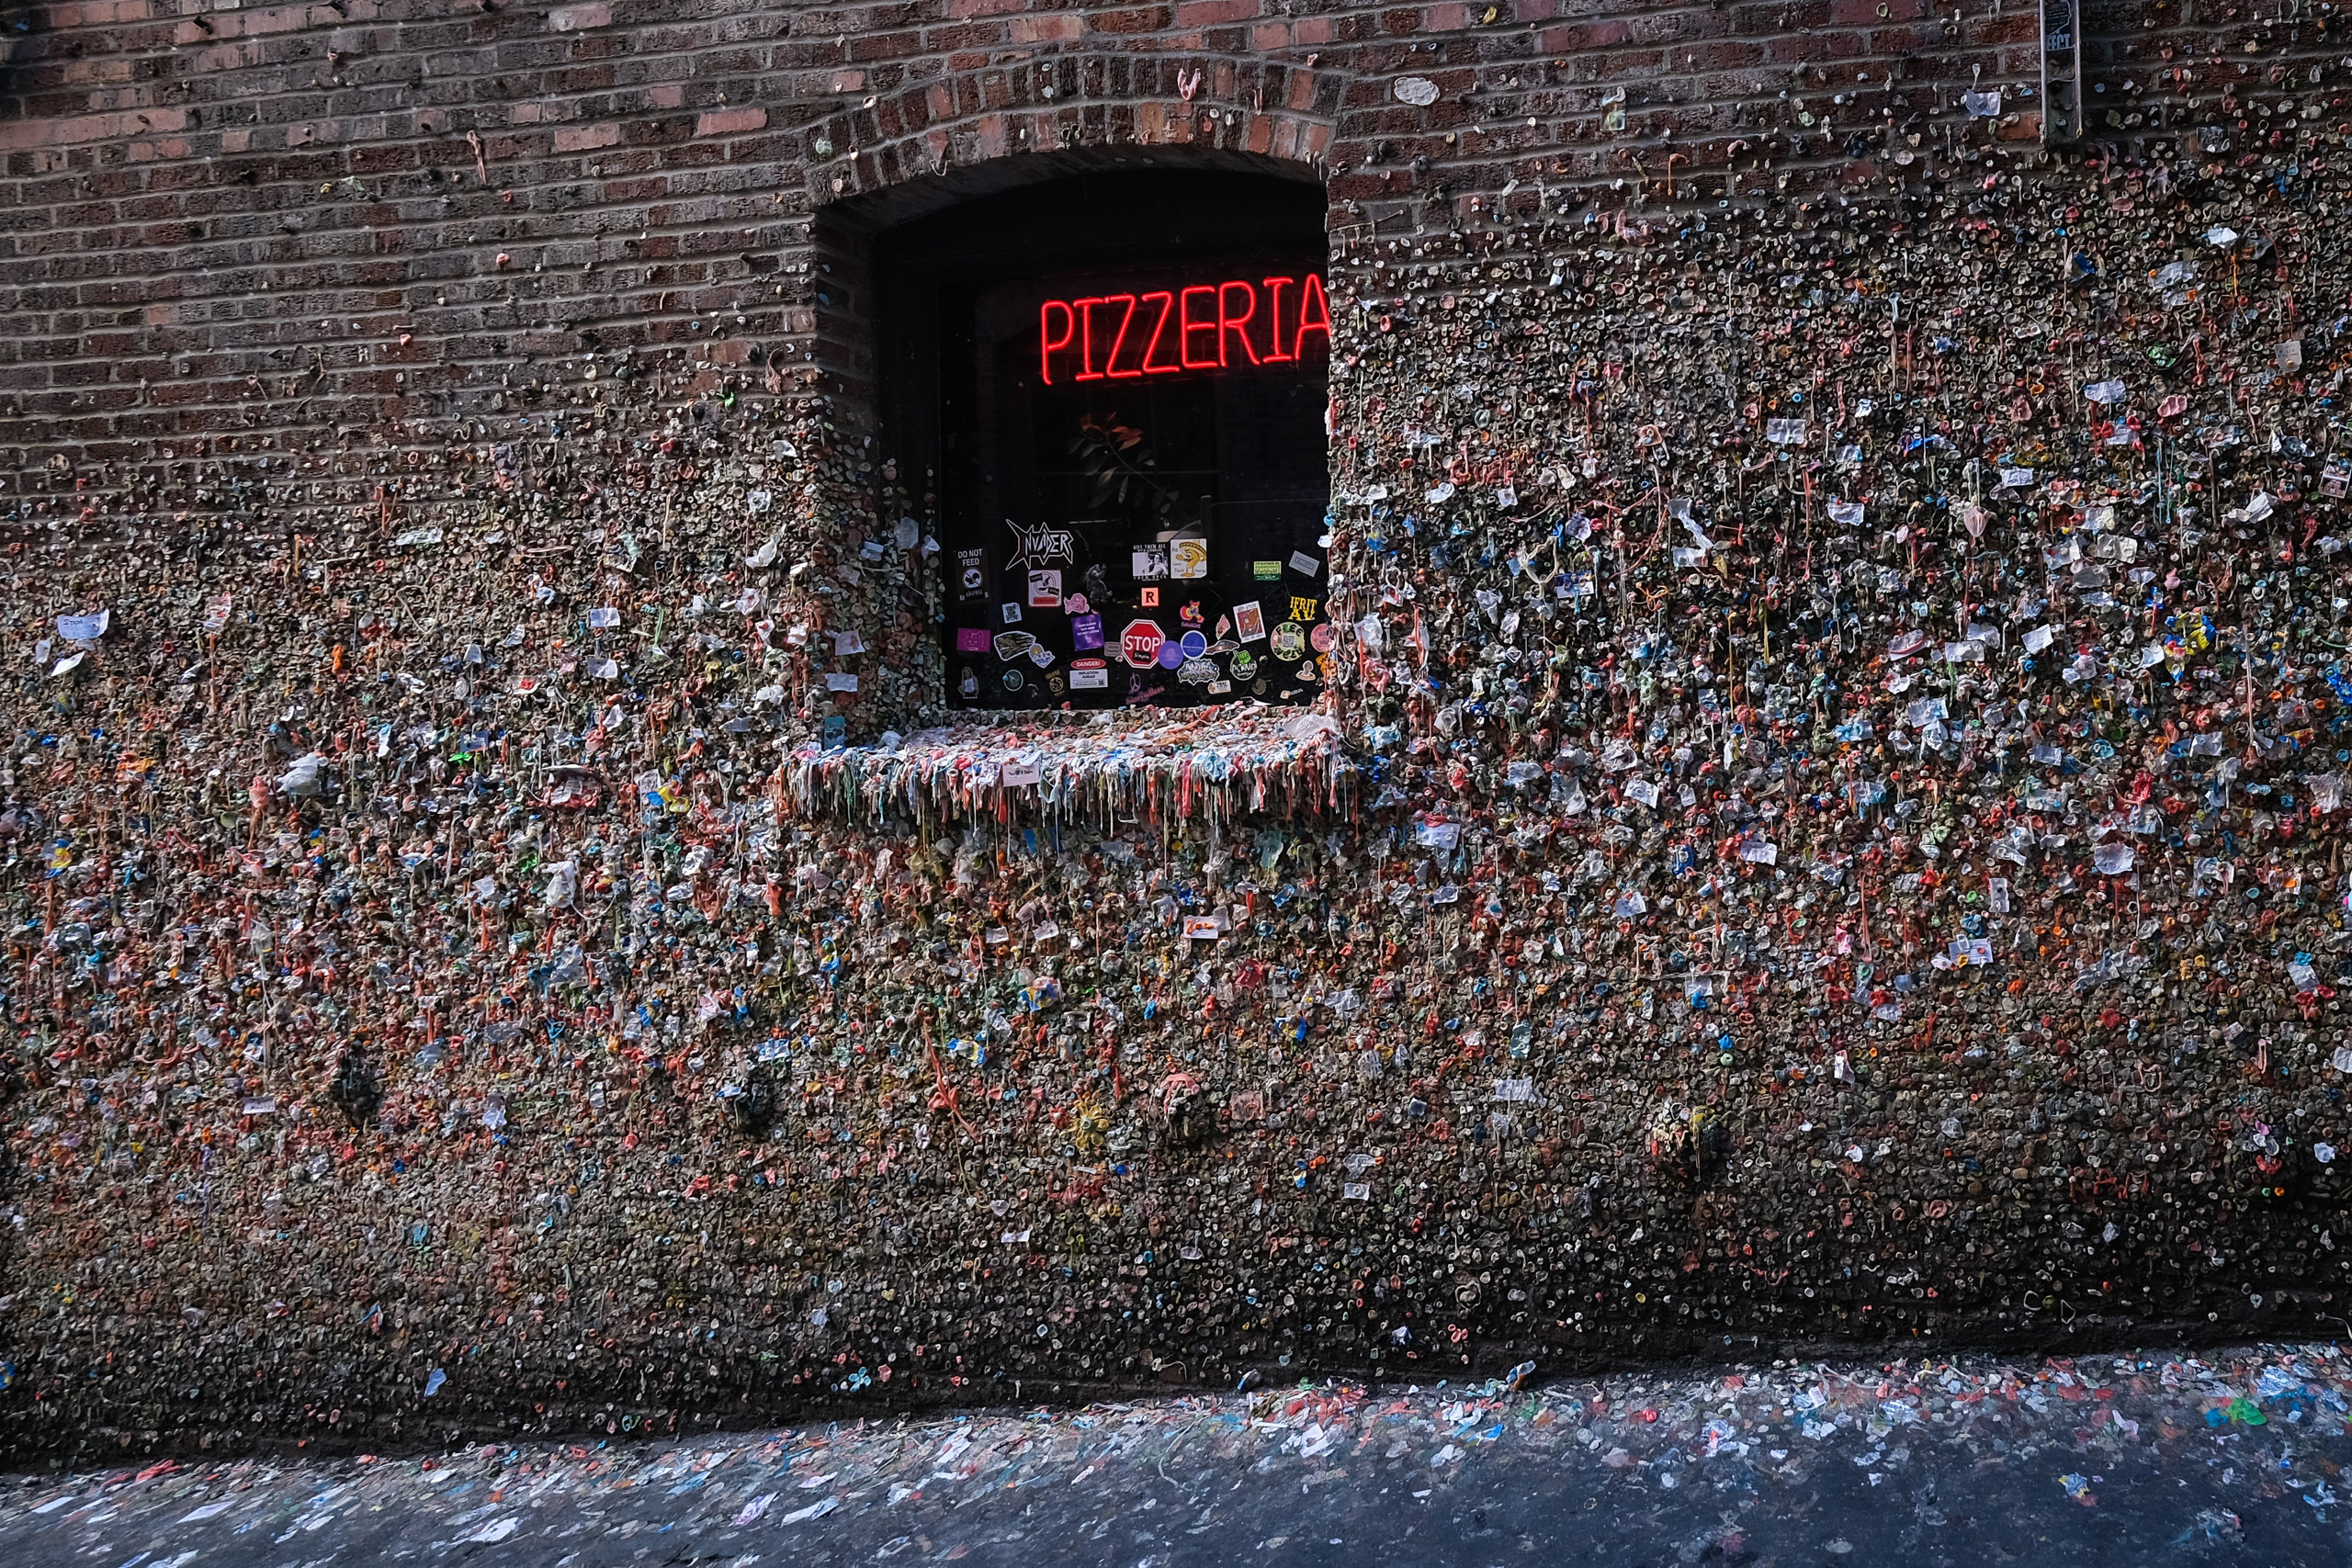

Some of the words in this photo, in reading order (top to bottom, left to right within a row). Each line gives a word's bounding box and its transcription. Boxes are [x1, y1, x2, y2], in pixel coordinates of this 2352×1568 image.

[1040, 273, 1330, 386] PIZZERIA
[1008, 522, 1072, 565] INVADER
[957, 550, 968, 558] DO
[968, 548, 983, 558] NOT
[962, 558, 980, 567] FEED
[1145, 591, 1156, 603] R
[1289, 596, 1317, 611] IFRIT
[1275, 625, 1304, 637] FEE
[1125, 635, 1160, 652] STOP
